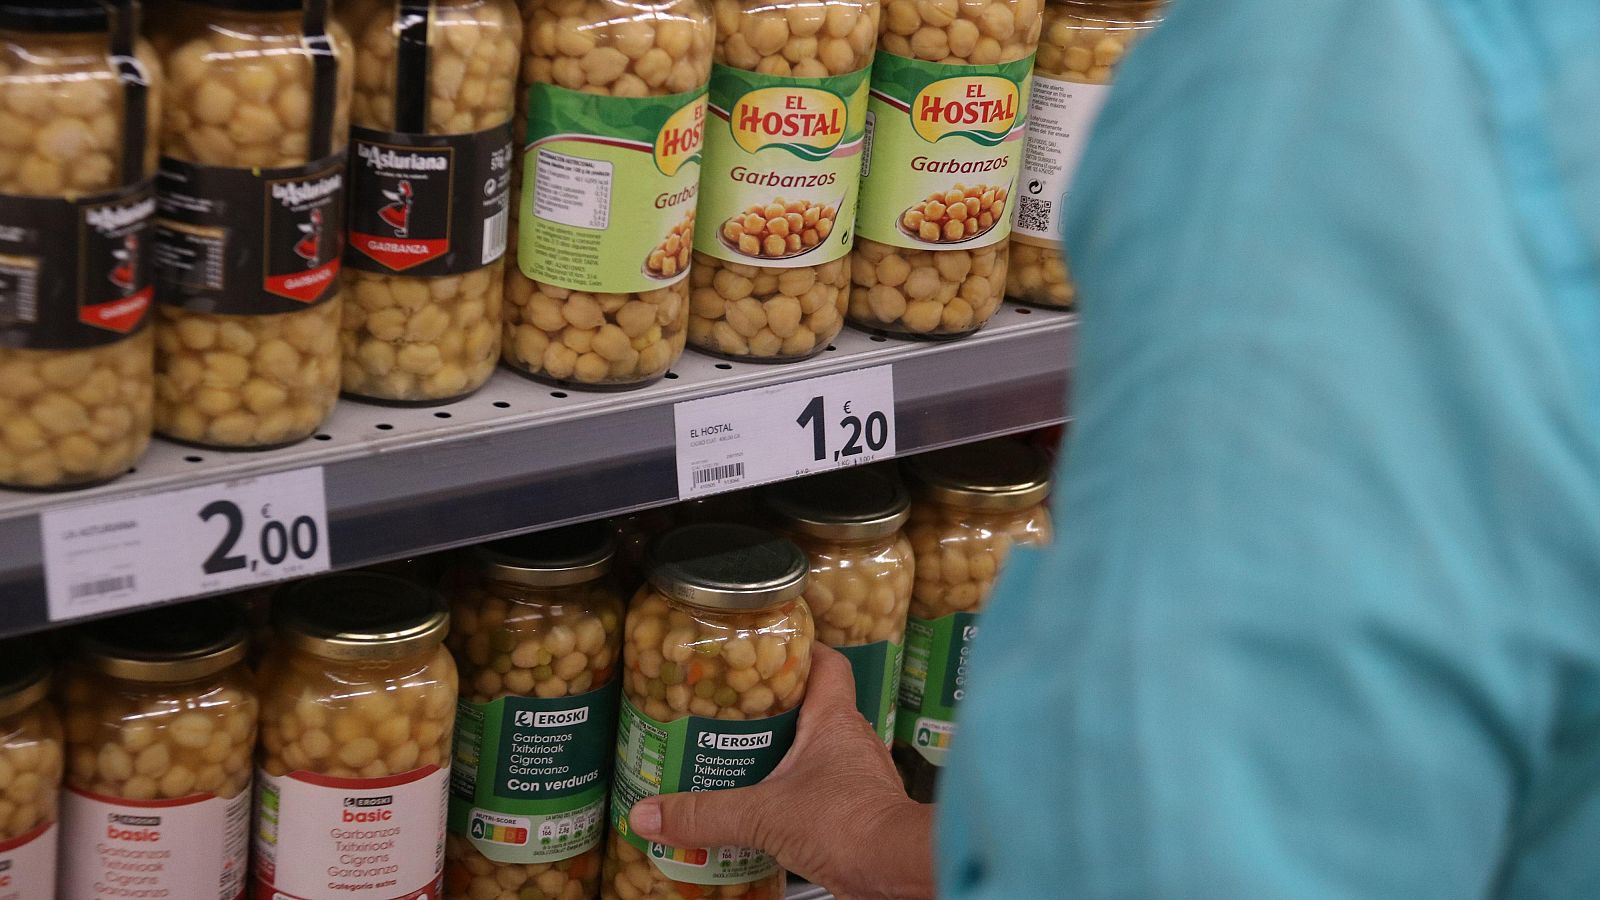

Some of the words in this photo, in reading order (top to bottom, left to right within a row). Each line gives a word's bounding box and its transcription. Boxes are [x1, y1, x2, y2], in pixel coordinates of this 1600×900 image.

[966, 84, 986, 98] EL
[785, 95, 807, 110] EL
[920, 94, 1014, 124] HOSTAL
[739, 104, 841, 137] HOSTAL
[366, 146, 447, 171] Asturiana
[910, 154, 1009, 174] Garbanzos
[730, 166, 836, 188] Garbanzos
[368, 240, 429, 254] GARBANZA
[690, 430, 699, 438] EL
[701, 423, 734, 436] HOSTAL
[538, 710, 585, 725] EROSKI
[513, 732, 573, 744] Garbanzos
[721, 734, 769, 747] EROSKI
[919, 732, 929, 743] A
[511, 743, 564, 754] Txitxirioak
[510, 754, 553, 766] Cigrons
[695, 753, 755, 766] Garbanzos
[509, 764, 569, 776] Garavanzo
[694, 764, 746, 776] Txitxirioak
[507, 778, 540, 792] Con
[544, 769, 599, 791] verduras
[692, 775, 735, 788] Cigrons
[357, 796, 391, 806] EROSKI
[342, 808, 392, 823] basic
[476, 812, 517, 825] NUTRI-SCORE
[107, 825, 160, 842] basic
[330, 825, 400, 839] Garbanzos
[473, 823, 483, 835] A
[97, 843, 170, 859] Garbanzos
[335, 840, 395, 852] Txitxirioak
[653, 844, 663, 854] A
[340, 853, 389, 867] Cigrons
[327, 864, 398, 878] Garavanzo
[106, 871, 158, 886] Cigrons
[375, 879, 397, 889] extra
[94, 882, 169, 898] Garavanzo
